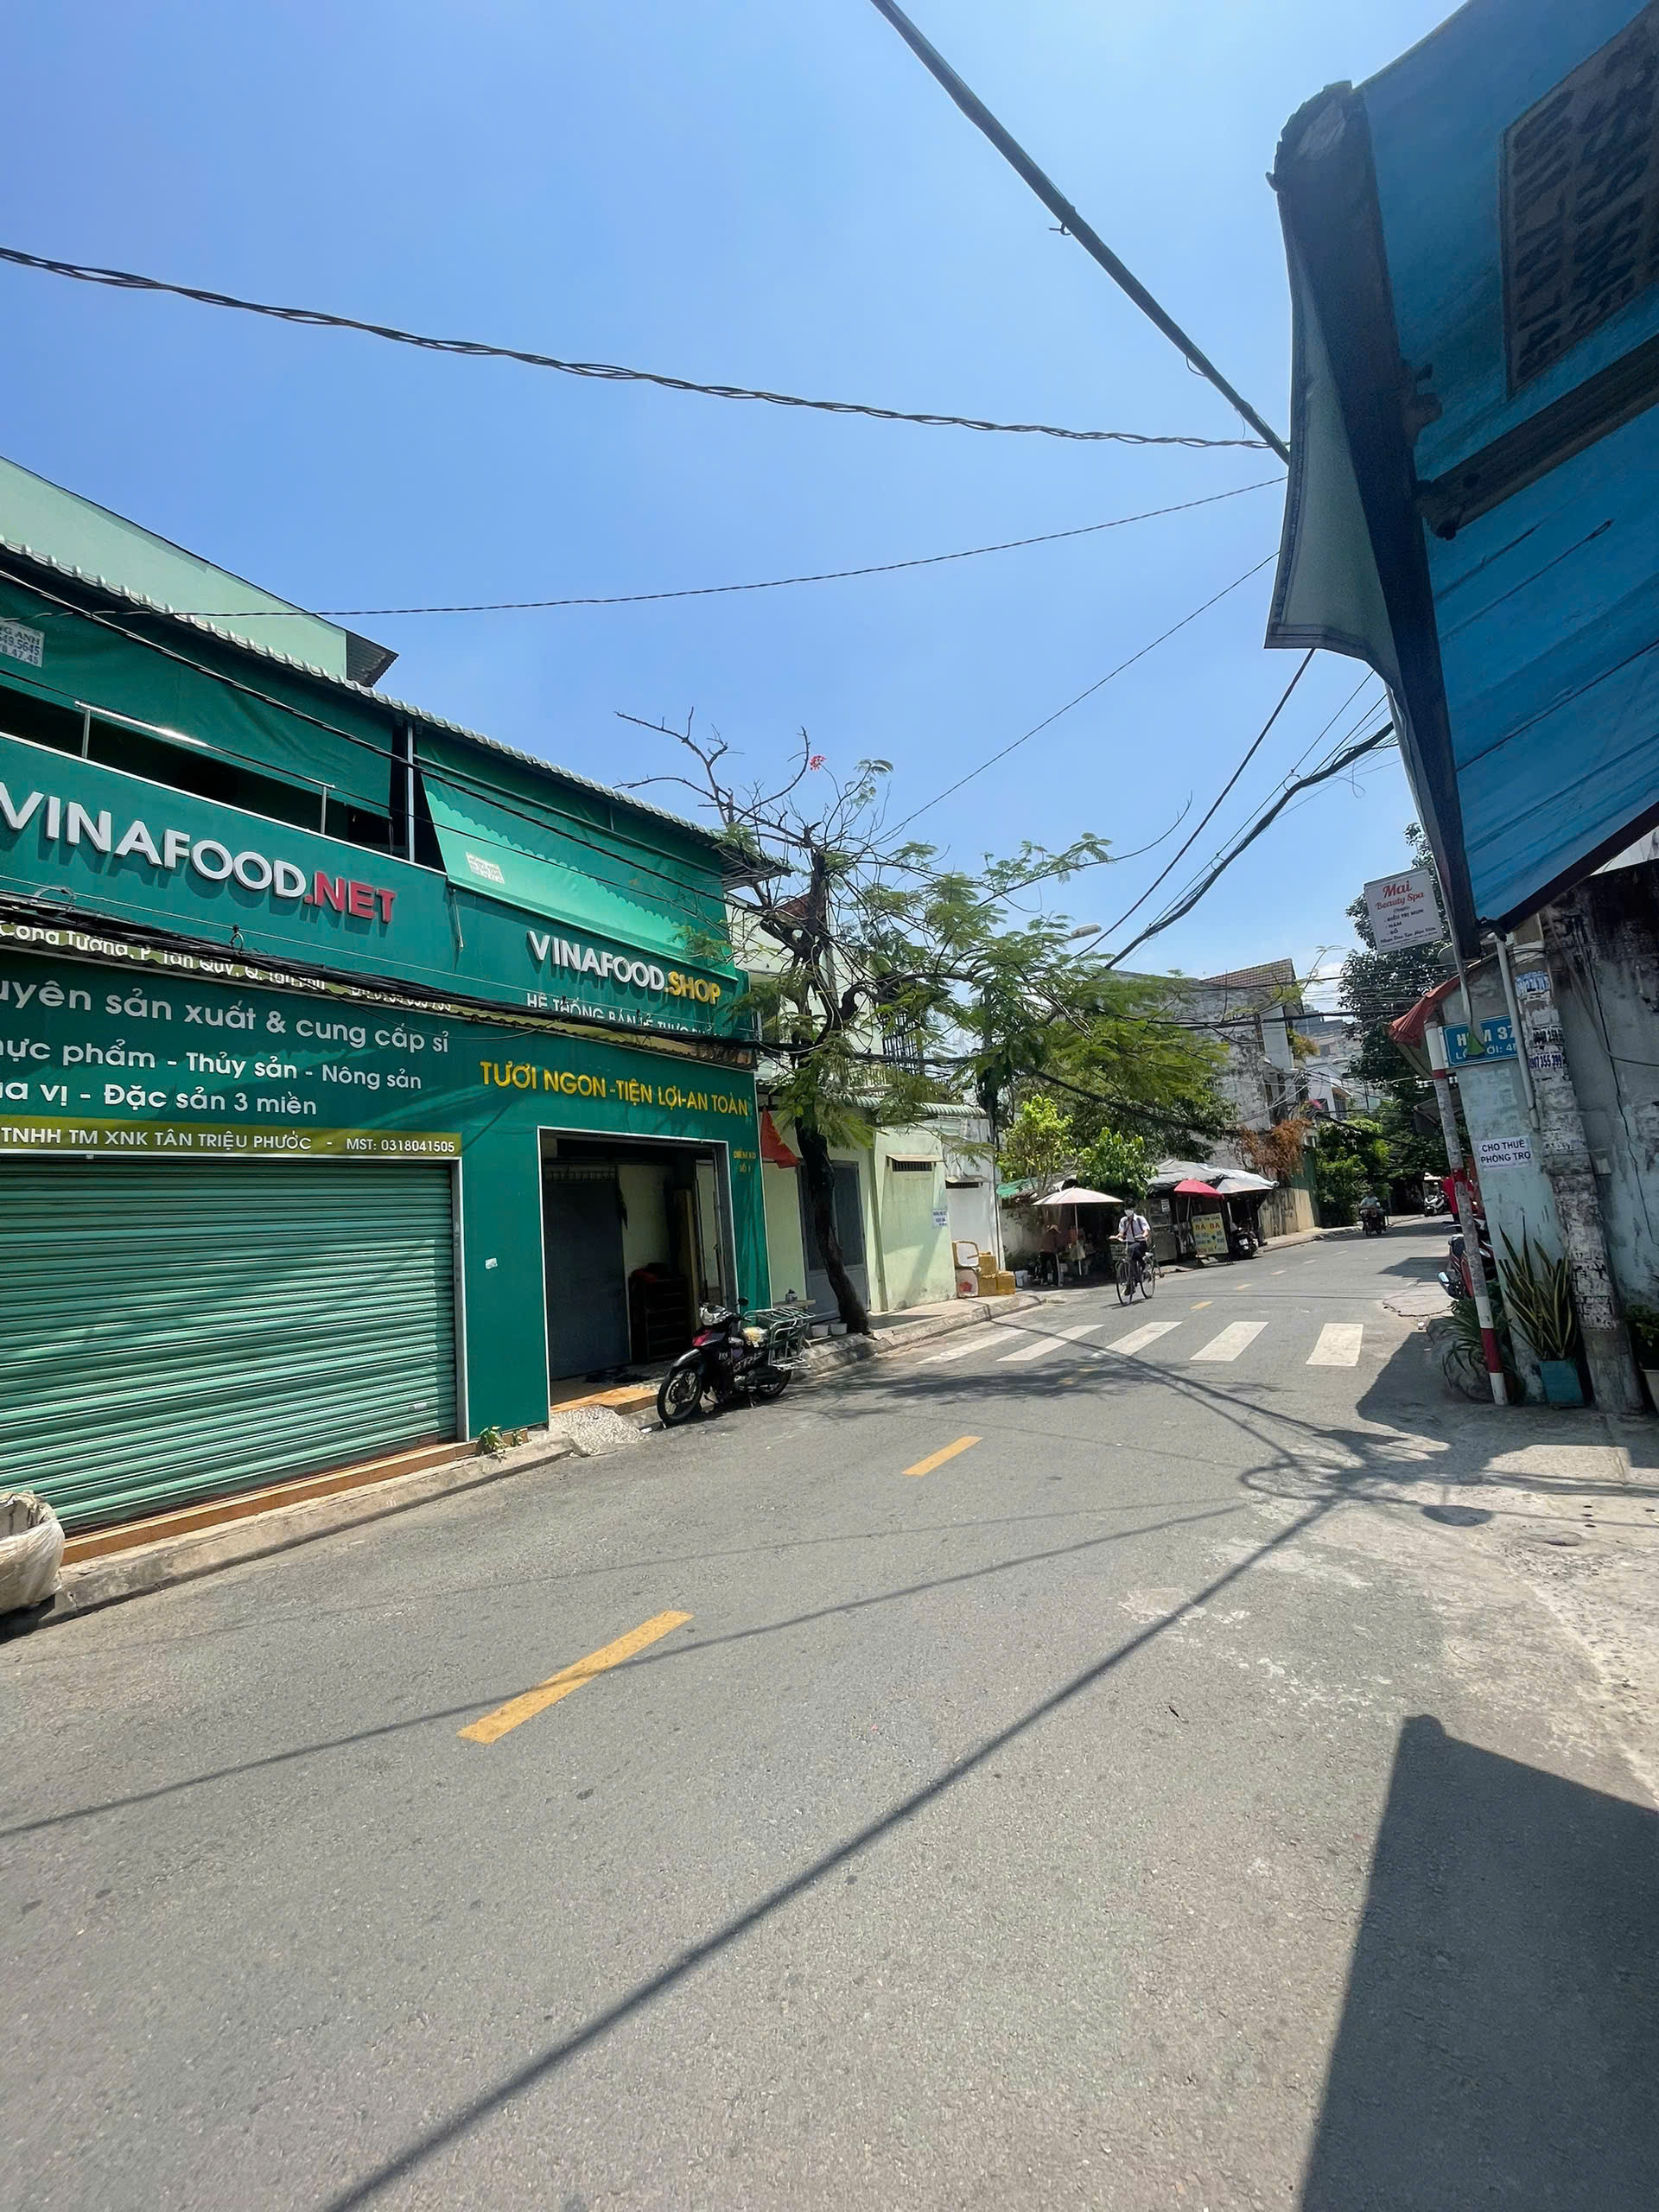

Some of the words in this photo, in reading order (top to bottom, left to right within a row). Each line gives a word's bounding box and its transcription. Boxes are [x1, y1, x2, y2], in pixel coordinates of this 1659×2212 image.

[0, 781, 397, 923] VINAFOOD.NET
[1376, 898, 1405, 910] Beauty
[1407, 892, 1424, 902] Spa
[1382, 880, 1413, 898] Mai
[527, 931, 721, 1005] VINAFOOD.SHOP
[105, 988, 172, 1020] sản
[184, 1000, 256, 1030] xuất
[266, 1011, 286, 1033] &
[296, 1019, 366, 1048] cung
[375, 1023, 425, 1053] cấp
[433, 1031, 448, 1052] sỉ
[1456, 1028, 1492, 1047] HM
[0, 1038, 51, 1062] ực
[62, 1039, 156, 1068] phẩm
[186, 1051, 246, 1078] Thủy
[254, 1056, 297, 1079] sản
[322, 1065, 380, 1090] Nông
[386, 1068, 422, 1089] sản
[39, 1084, 67, 1106] vị
[104, 1084, 167, 1110] Đặc
[175, 1086, 226, 1110] sản
[233, 1092, 249, 1112] 3
[257, 1091, 317, 1115] miền
[480, 1060, 537, 1090] TƯƠI
[543, 1069, 606, 1097] NGON
[711, 1092, 749, 1116] TOÀN
[1, 1127, 61, 1144] TNHH
[68, 1129, 98, 1145] TM
[105, 1130, 148, 1146] XNK
[155, 1128, 192, 1147] TÂN
[198, 1130, 248, 1151] TRIỆU
[253, 1130, 312, 1151] PHƯỚC
[346, 1138, 377, 1151] MST:
[381, 1139, 455, 1153] 0318041505
[1482, 1142, 1500, 1153] CHO
[1501, 1138, 1525, 1150] THUÊ
[1480, 1153, 1511, 1164] PHÒNG
